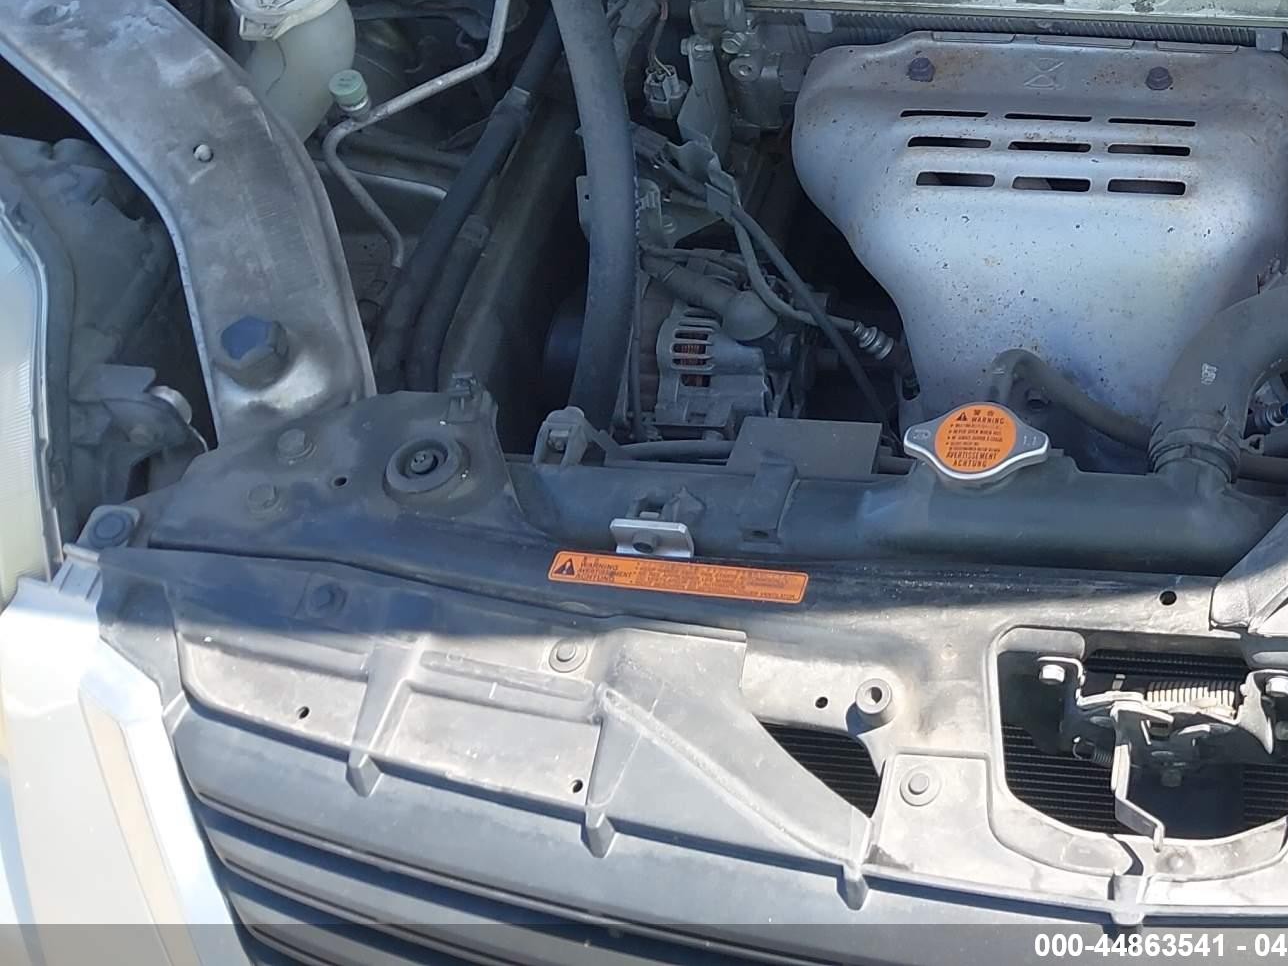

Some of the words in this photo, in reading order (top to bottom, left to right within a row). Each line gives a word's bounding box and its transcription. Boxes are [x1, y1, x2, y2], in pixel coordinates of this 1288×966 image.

[971, 417, 1005, 425] WARNING
[945, 451, 997, 460] AVERTISSEMENT
[952, 459, 987, 468] ACHTUNG
